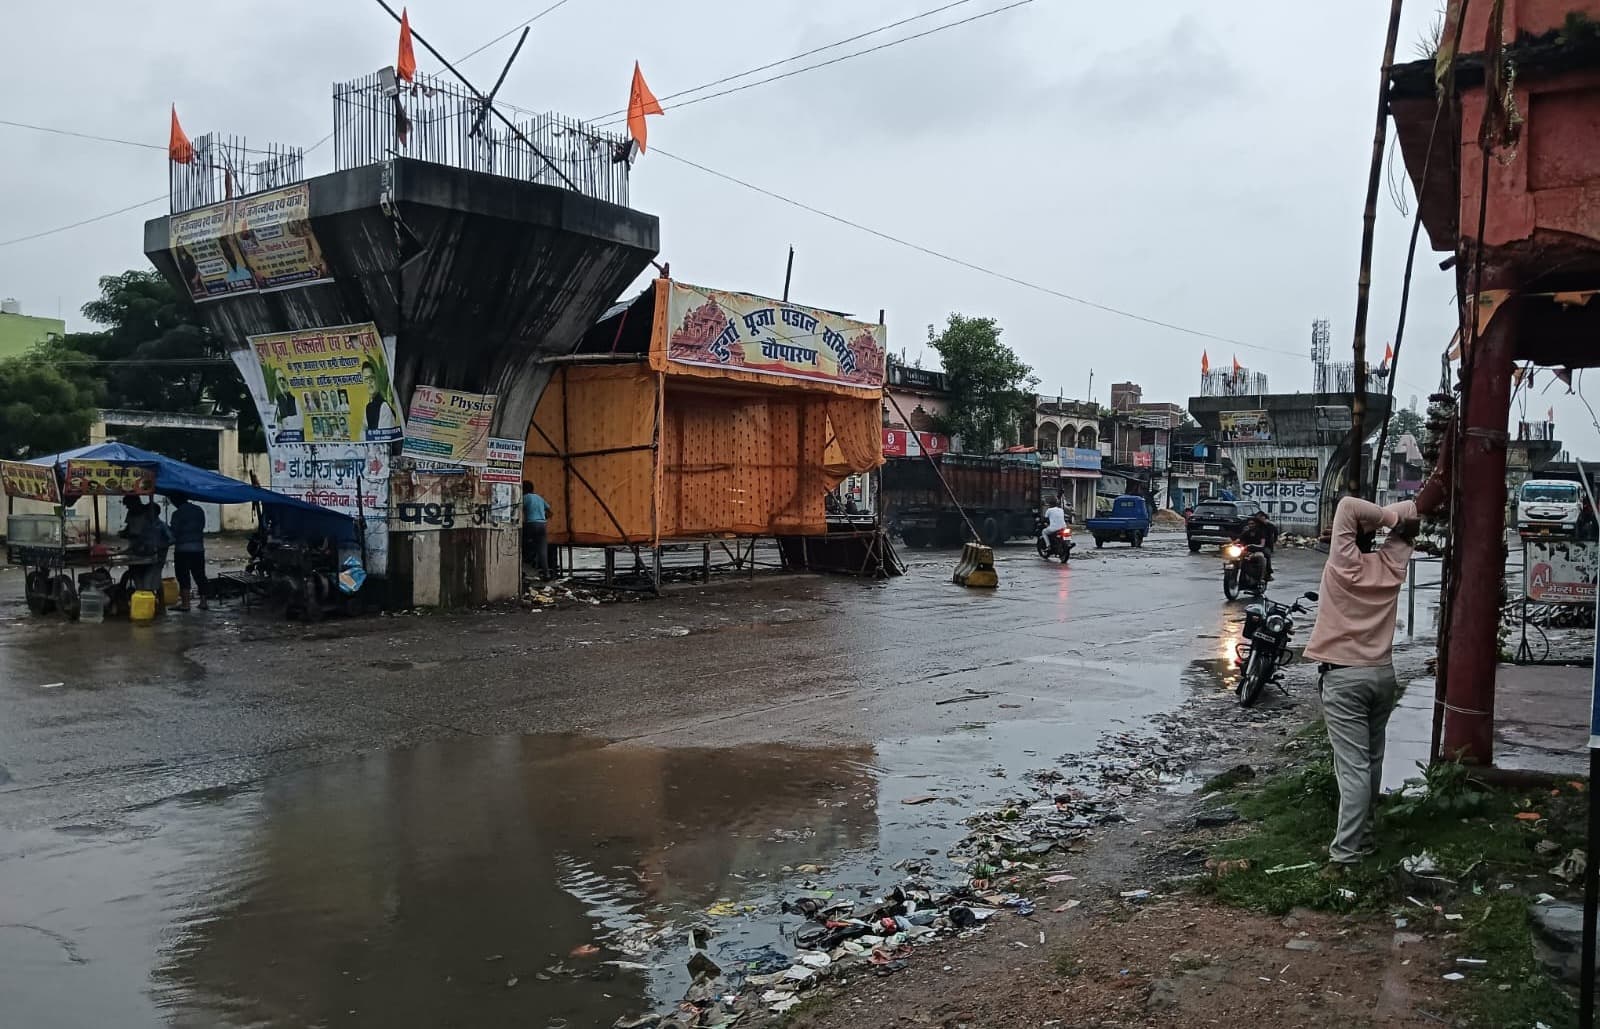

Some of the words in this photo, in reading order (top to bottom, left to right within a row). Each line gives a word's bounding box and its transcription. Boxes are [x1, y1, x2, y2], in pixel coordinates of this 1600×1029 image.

[358, 332, 377, 355] पूजा
[708, 316, 741, 364] दुर्गा
[743, 307, 775, 336] पूजा
[823, 325, 857, 376] समिति
[761, 337, 818, 366] चौपारण
[418, 389, 445, 405] M.S.
[451, 395, 492, 412] Physics
[334, 458, 366, 486] कुमार
[1242, 482, 1278, 498] शादी
[396, 502, 454, 529] पशु
[1261, 501, 1317, 514] TDC
